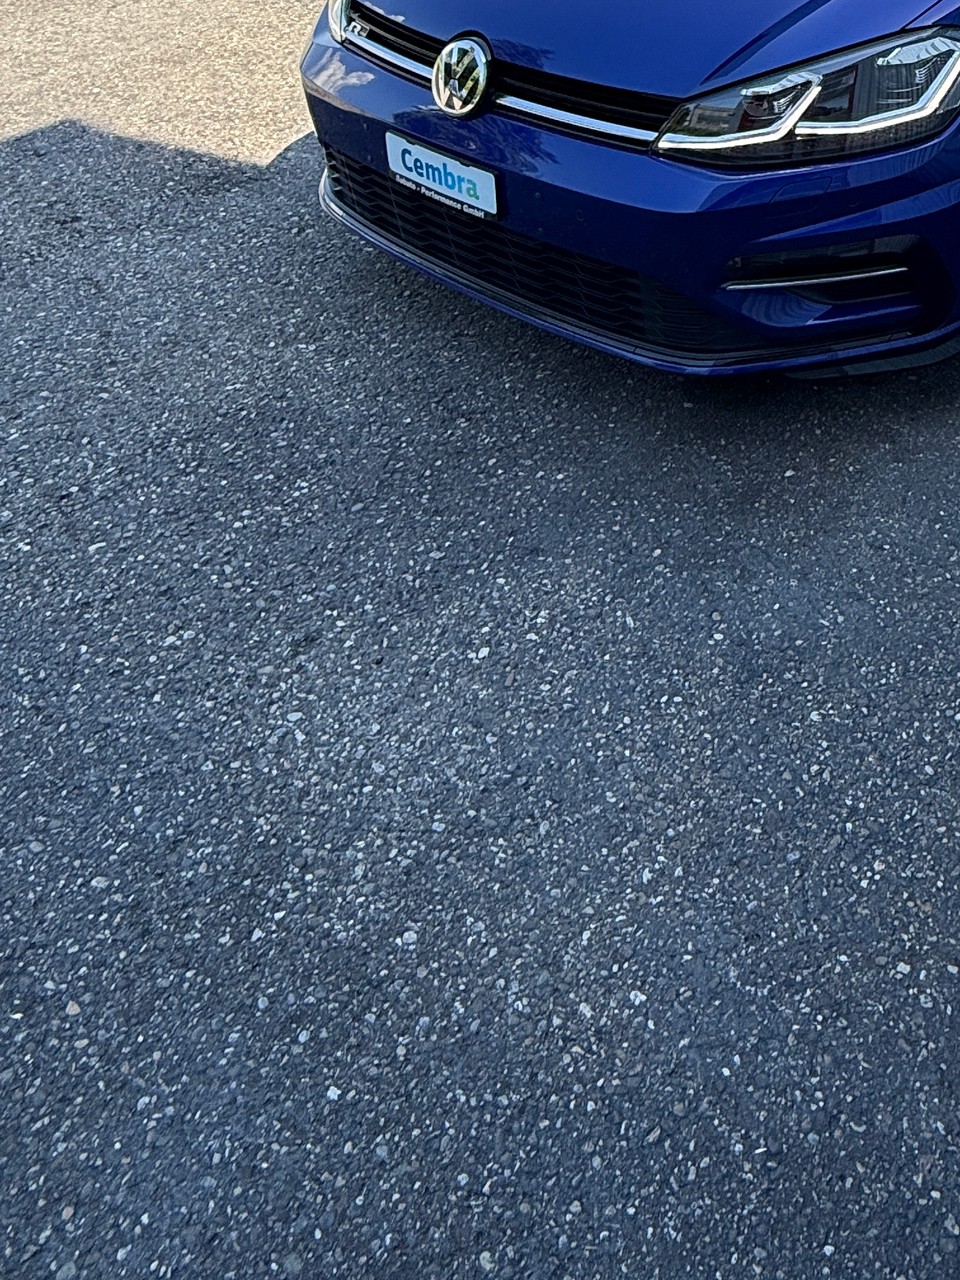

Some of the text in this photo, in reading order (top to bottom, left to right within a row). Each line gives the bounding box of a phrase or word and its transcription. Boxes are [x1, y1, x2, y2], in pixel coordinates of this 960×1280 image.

[401, 148, 480, 201] Cembra
[421, 186, 462, 210] Performance
[462, 204, 485, 219] GmbH
